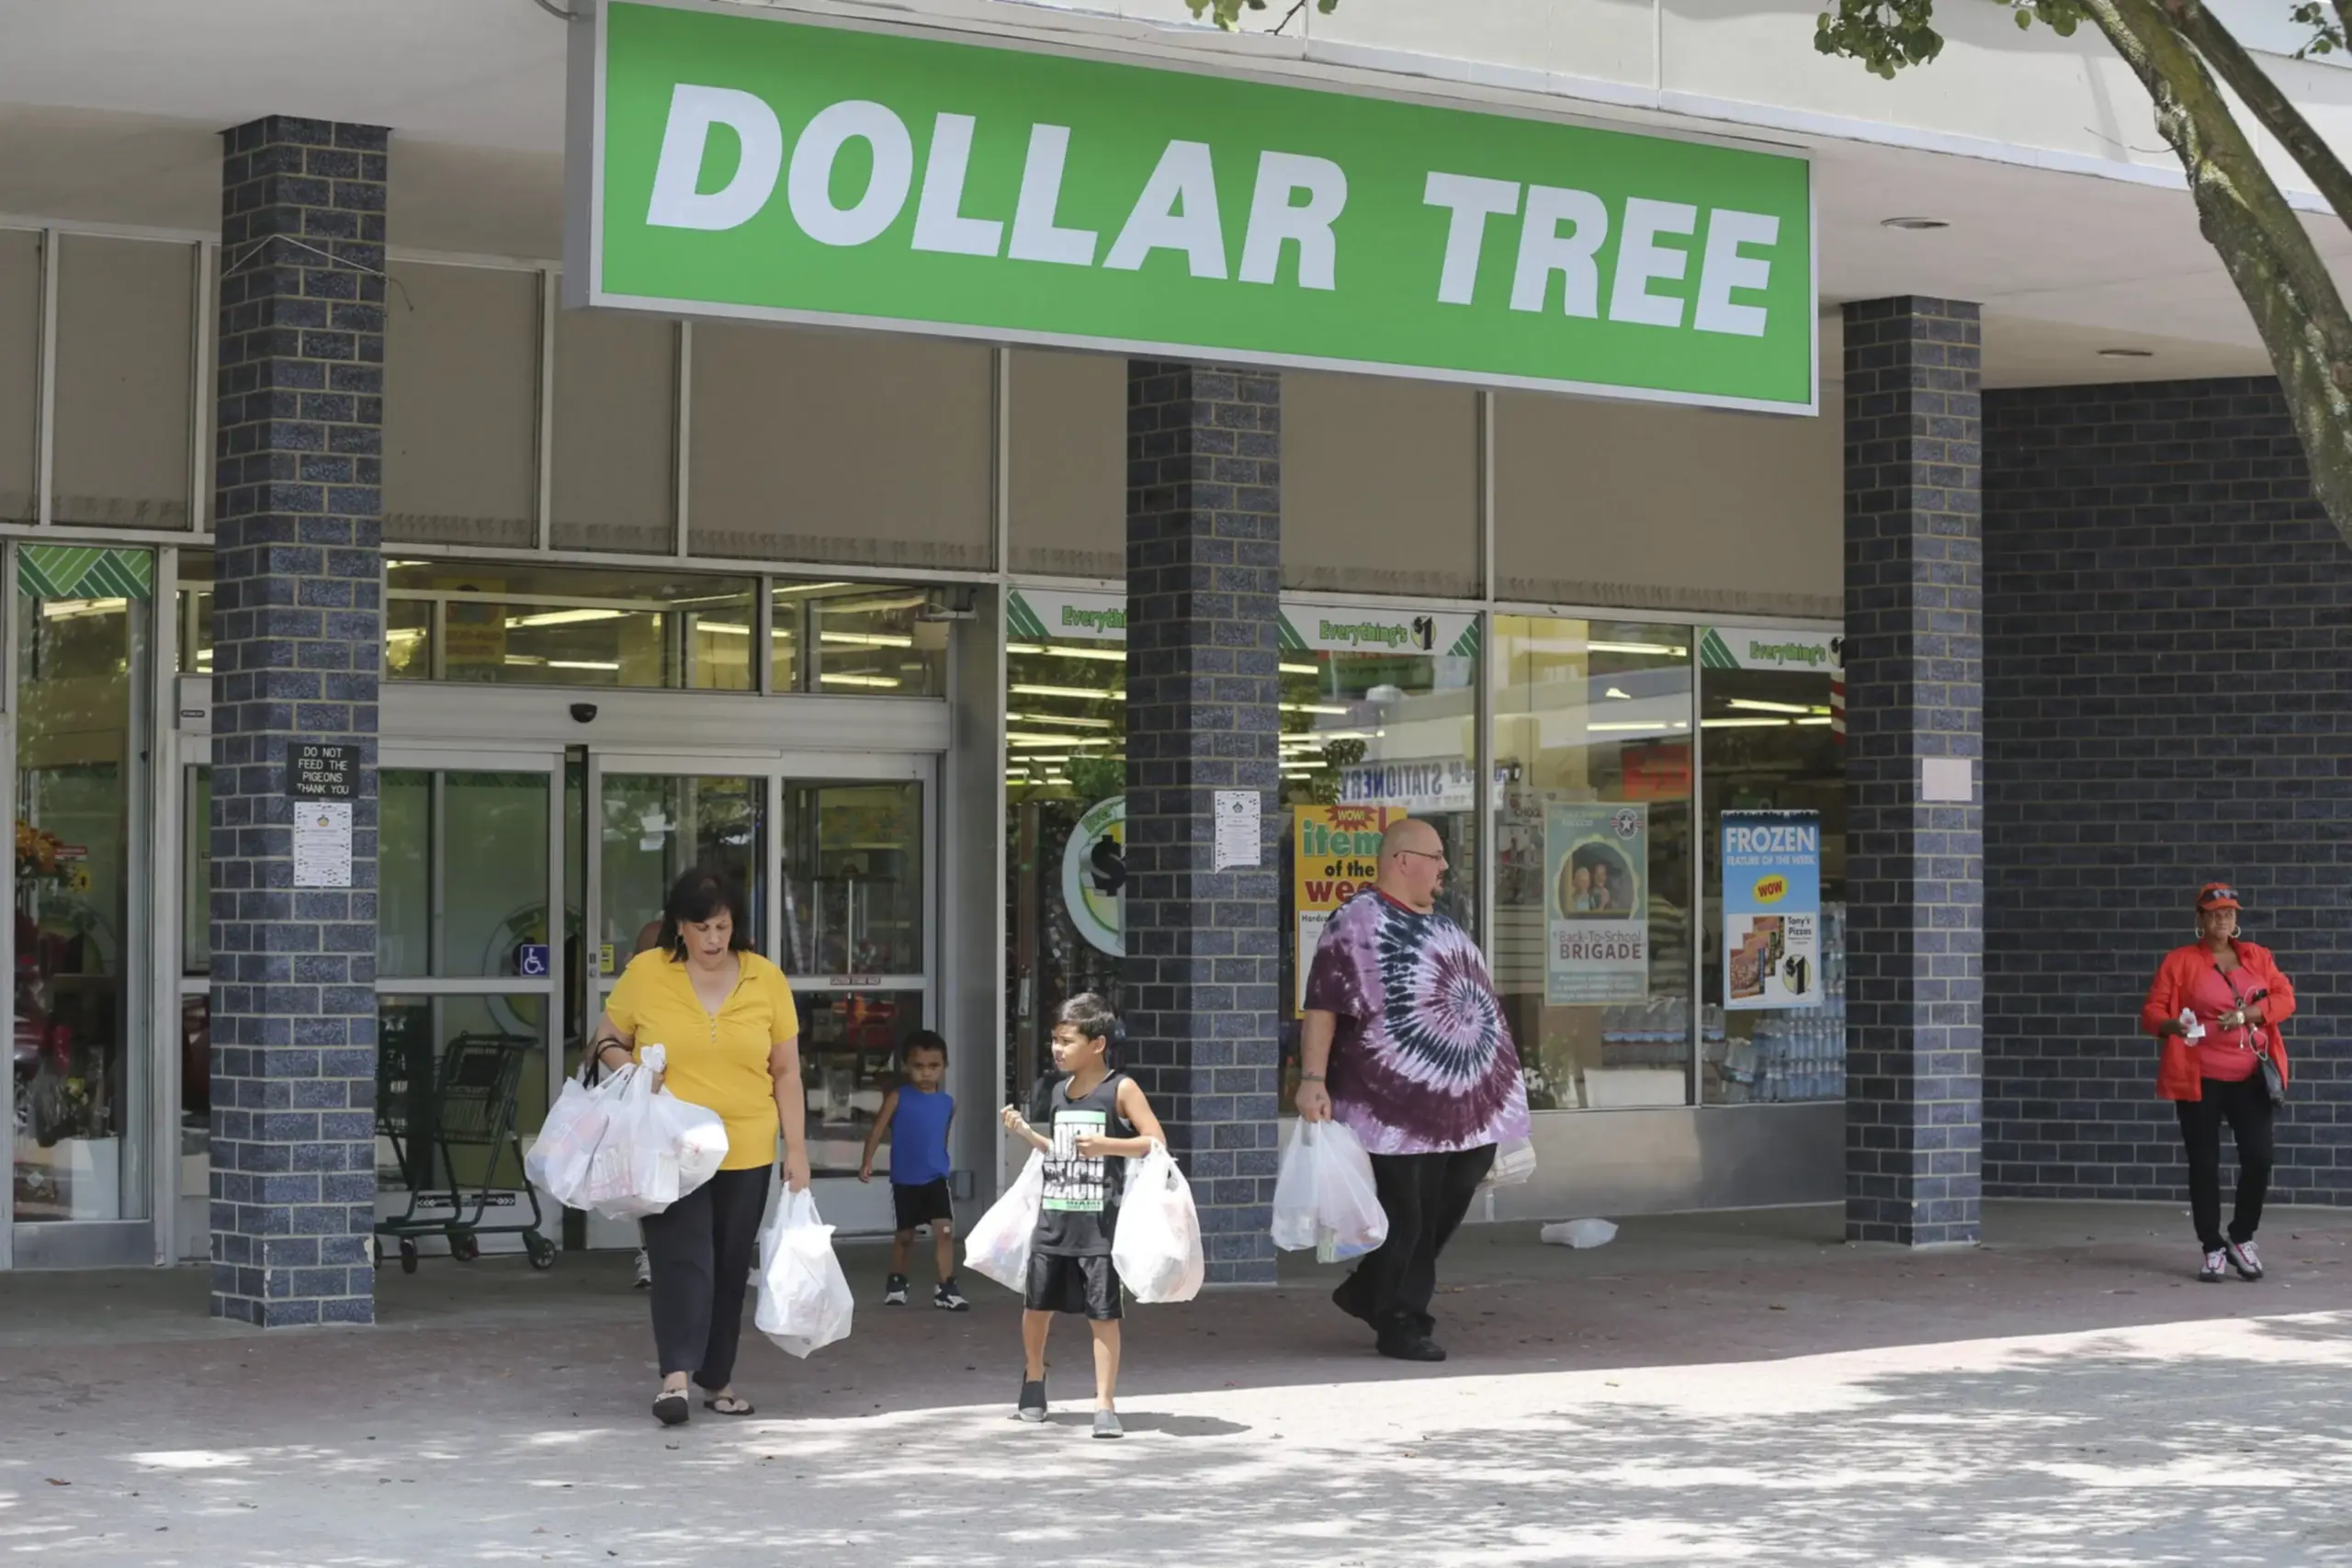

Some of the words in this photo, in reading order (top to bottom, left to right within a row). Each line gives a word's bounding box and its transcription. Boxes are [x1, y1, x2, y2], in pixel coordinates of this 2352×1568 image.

[646, 83, 1348, 291] DOLLAR
[1423, 171, 1781, 337] TREE
[1319, 619, 1408, 649] Everything's
[1412, 615, 1433, 650] $1
[303, 746, 318, 757] DO
[322, 748, 343, 758] NOT
[298, 759, 324, 770] FEED
[329, 761, 348, 771] THE
[302, 772, 343, 783] PIGEONS
[296, 784, 326, 794] THANK
[331, 784, 349, 795] YOU
[1338, 809, 1365, 821] WOW!
[1303, 818, 1383, 856] item
[1726, 826, 1815, 854] FROZEN
[1726, 856, 1759, 866] FEATURE
[1761, 856, 1774, 865] OF
[1776, 855, 1791, 865] THE
[1792, 855, 1816, 865] WEEK
[1325, 860, 1342, 877] of
[1347, 860, 1375, 877] the
[1758, 880, 1782, 897] WOW
[1787, 916, 1811, 927] Tony's
[1559, 929, 1641, 943] Back-To-School
[1788, 927, 1812, 935] Pizzas
[1559, 942, 1642, 960] BRIGADE
[1785, 955, 1806, 996] $1
